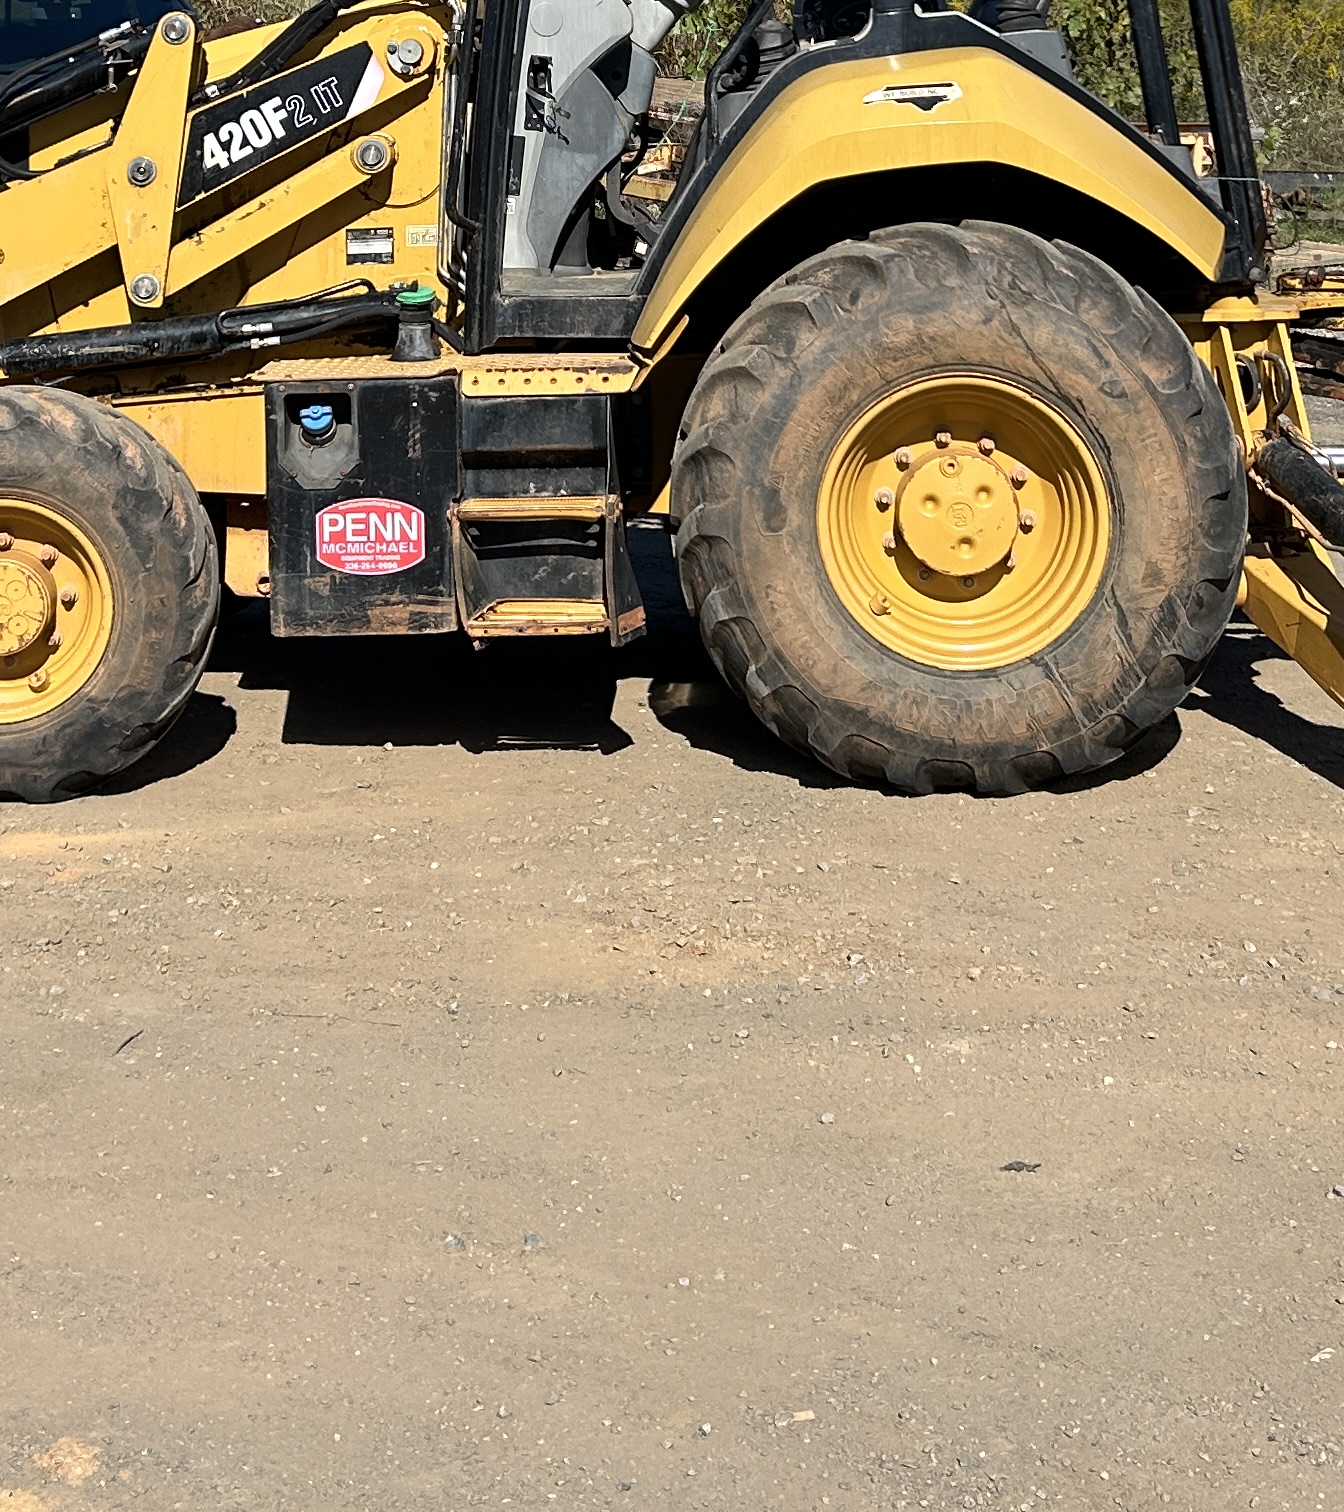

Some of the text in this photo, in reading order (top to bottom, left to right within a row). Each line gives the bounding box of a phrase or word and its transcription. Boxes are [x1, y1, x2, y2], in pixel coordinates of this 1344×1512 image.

[203, 76, 344, 170] 420F2 IT
[322, 512, 418, 542] PENN
[322, 542, 418, 554] MCMICHAEL
